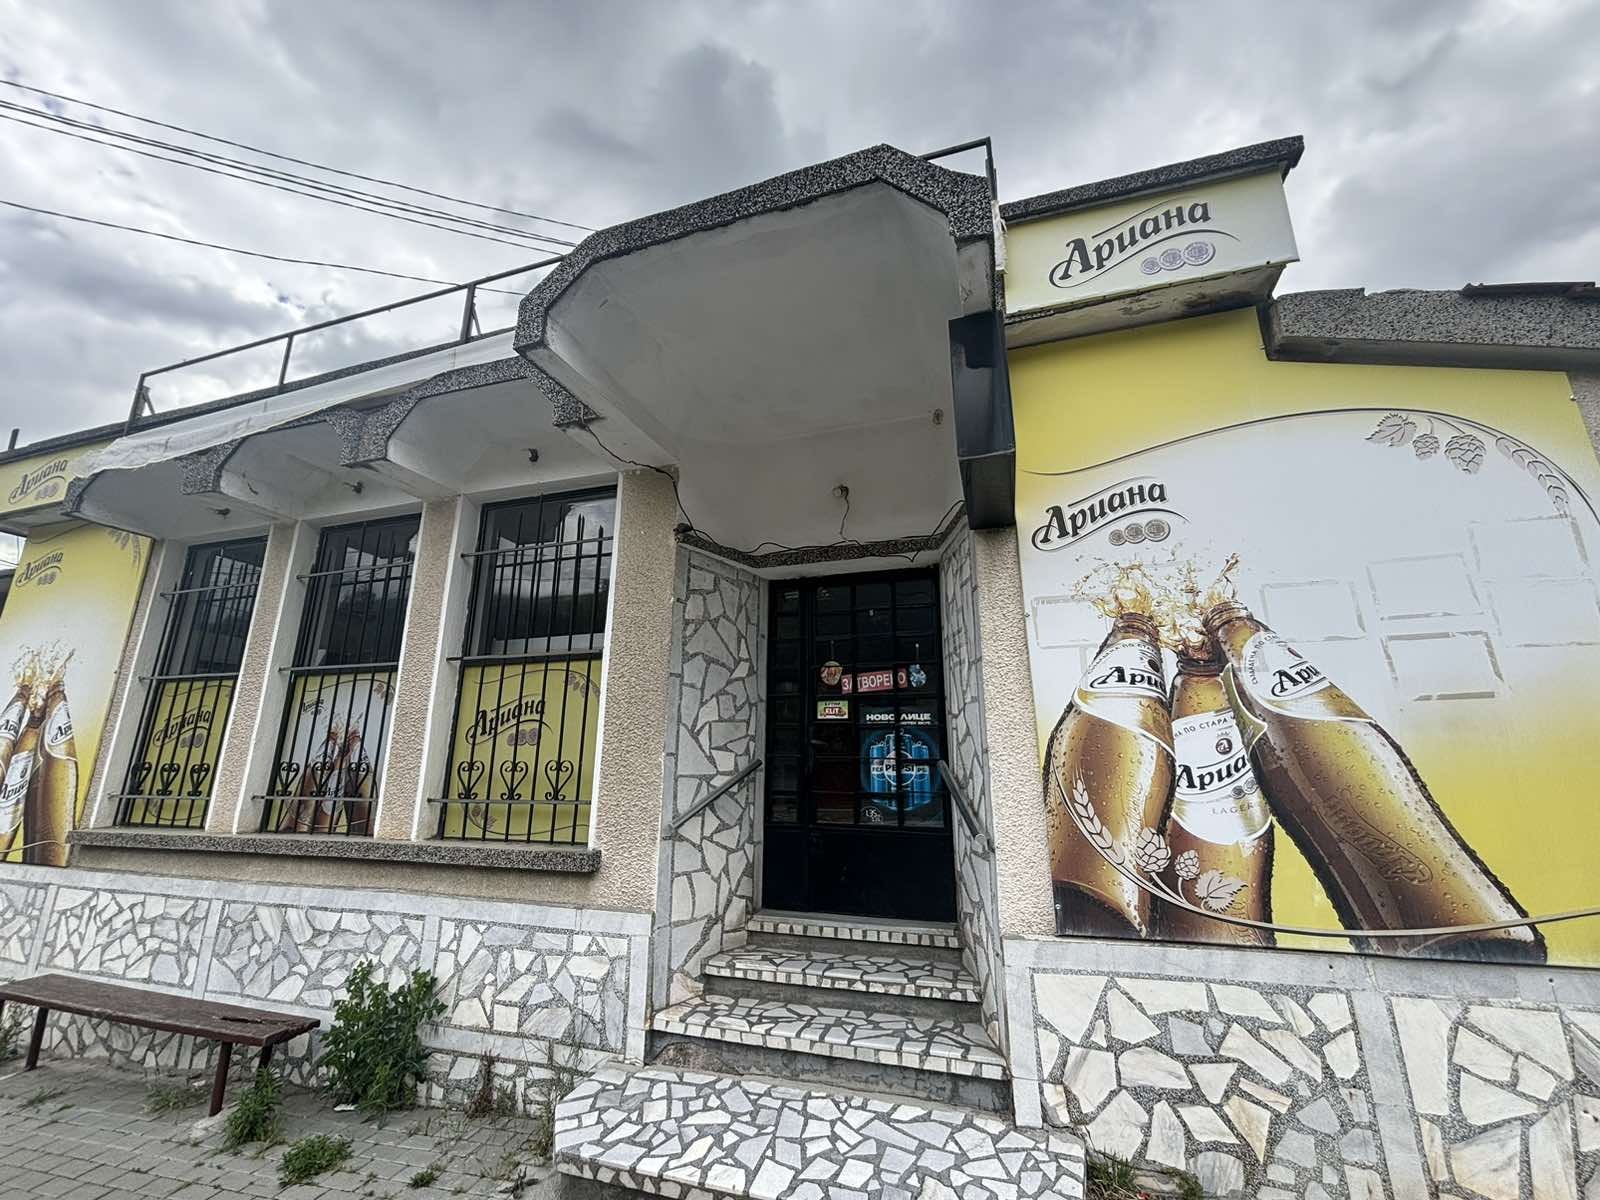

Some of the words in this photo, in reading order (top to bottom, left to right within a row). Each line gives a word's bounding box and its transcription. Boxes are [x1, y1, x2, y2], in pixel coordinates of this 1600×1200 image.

[1049, 201, 1212, 287] Ариана
[1031, 480, 1168, 549] Ариана
[842, 671, 906, 690] ЗТВОРЕО
[1184, 725, 1196, 735] ПО
[1199, 717, 1228, 730] СТАРА
[885, 763, 915, 772] PESI
[1211, 802, 1255, 815] LAGER
